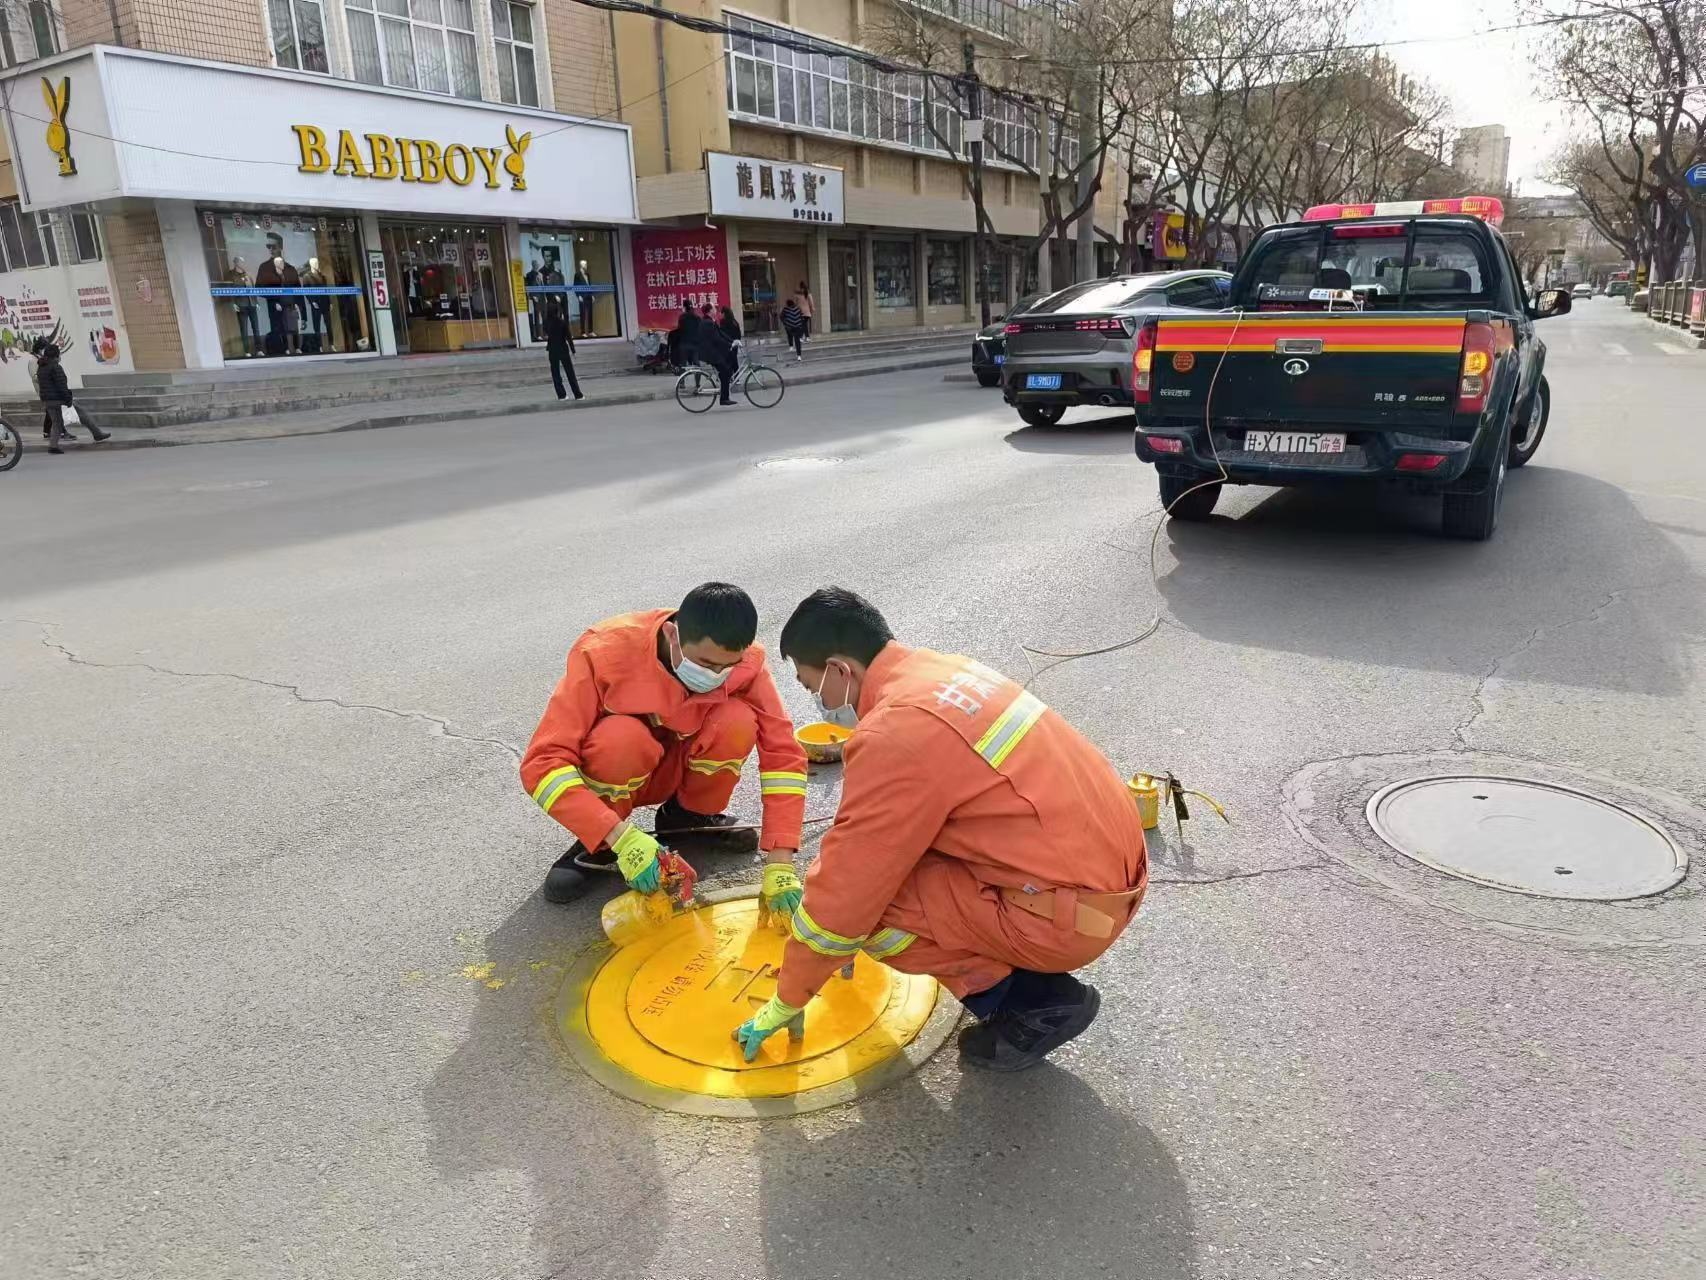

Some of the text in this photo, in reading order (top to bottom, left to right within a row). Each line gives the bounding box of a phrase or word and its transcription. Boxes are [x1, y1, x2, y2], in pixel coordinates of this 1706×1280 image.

[291, 124, 501, 189] BABIBOY
[643, 243, 716, 264] 在学习上下功夫
[646, 267, 717, 287] 在执行上铆足劲
[375, 280, 386, 306] 5
[648, 292, 719, 310] 在效能上见真章
